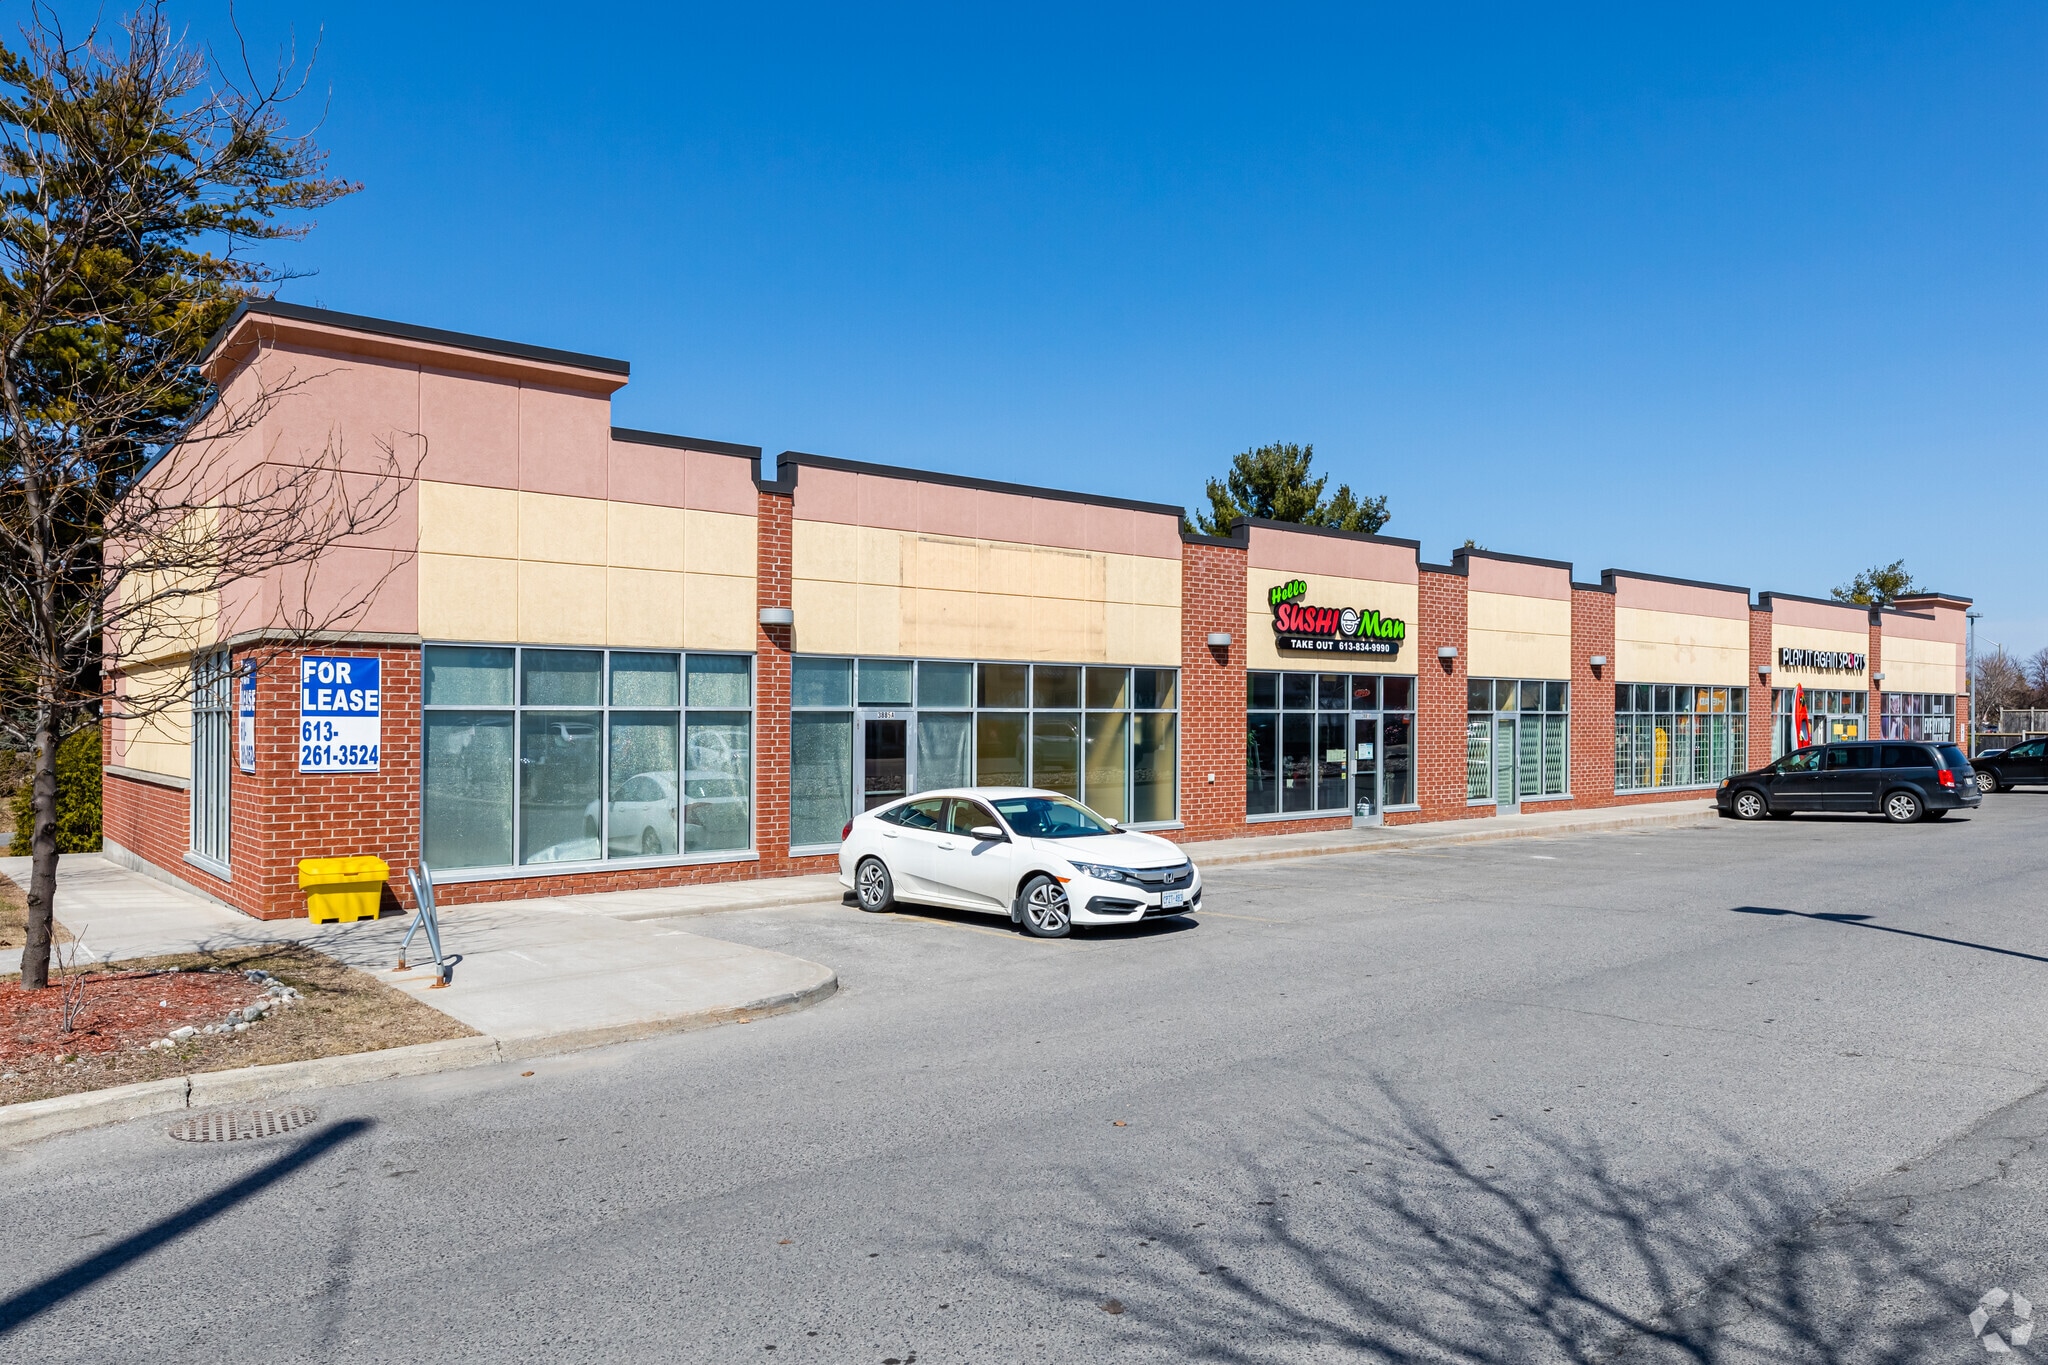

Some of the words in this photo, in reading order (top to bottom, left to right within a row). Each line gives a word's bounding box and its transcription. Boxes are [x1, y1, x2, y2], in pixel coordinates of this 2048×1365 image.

[1271, 580, 1306, 605] Hello
[1276, 603, 1340, 634] SUSHI
[1357, 611, 1404, 638] Man
[1290, 639, 1314, 649] TAKE
[1316, 640, 1334, 650] OUT
[1338, 641, 1390, 653] 613-834-9990
[1782, 647, 1804, 666] PLAY
[1805, 649, 1813, 667] IT
[1814, 650, 1838, 669] AGAIN
[1838, 652, 1866, 671] SPORTS
[303, 660, 352, 684] FOR
[303, 688, 379, 712] LEASE
[302, 720, 339, 742] 613-
[301, 744, 379, 766] 261-3524
